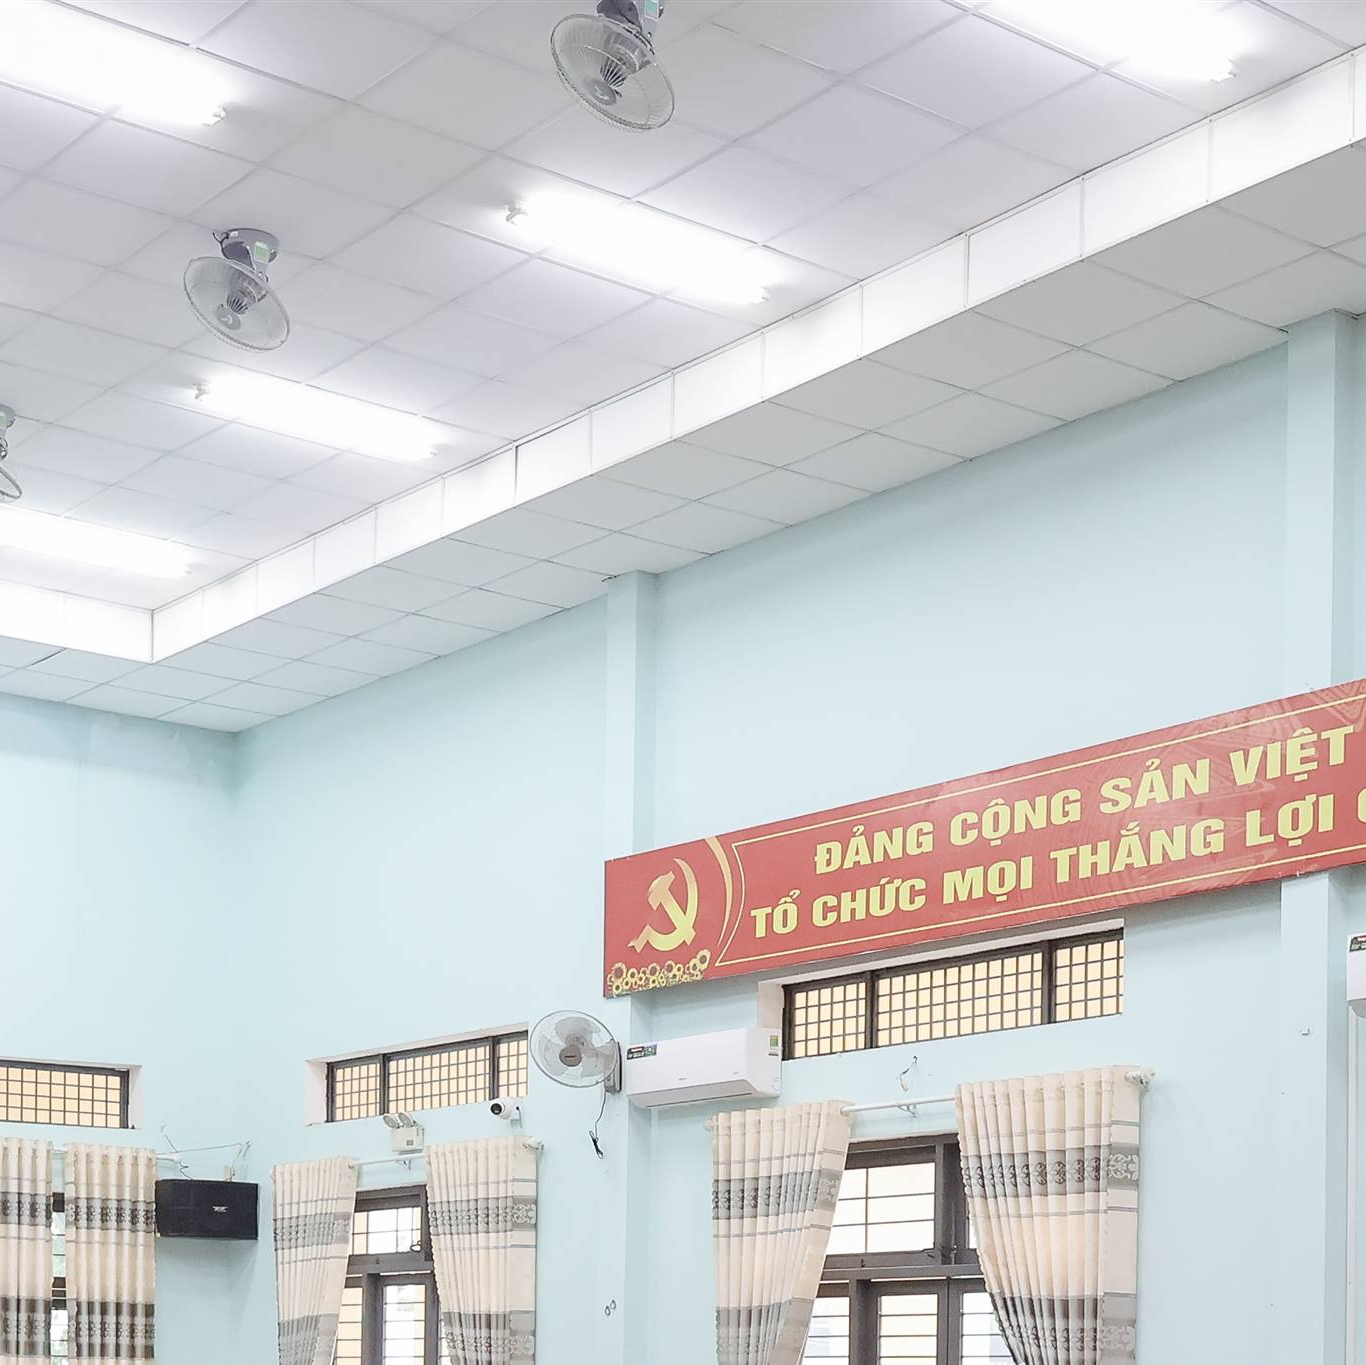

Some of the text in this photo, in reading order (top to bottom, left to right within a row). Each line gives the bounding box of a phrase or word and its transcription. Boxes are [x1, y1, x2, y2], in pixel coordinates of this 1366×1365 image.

[749, 888, 801, 939] TỔ
[811, 877, 928, 928] CHỨC
[942, 855, 1035, 905] MỌI
[1050, 816, 1227, 884] THẮNG
[1244, 793, 1335, 848] LỢI
[814, 822, 935, 875] ĐẢNG
[949, 788, 1083, 847] CỘNG
[1098, 758, 1212, 814] SẢN
[1229, 724, 1356, 785] VIỆT
